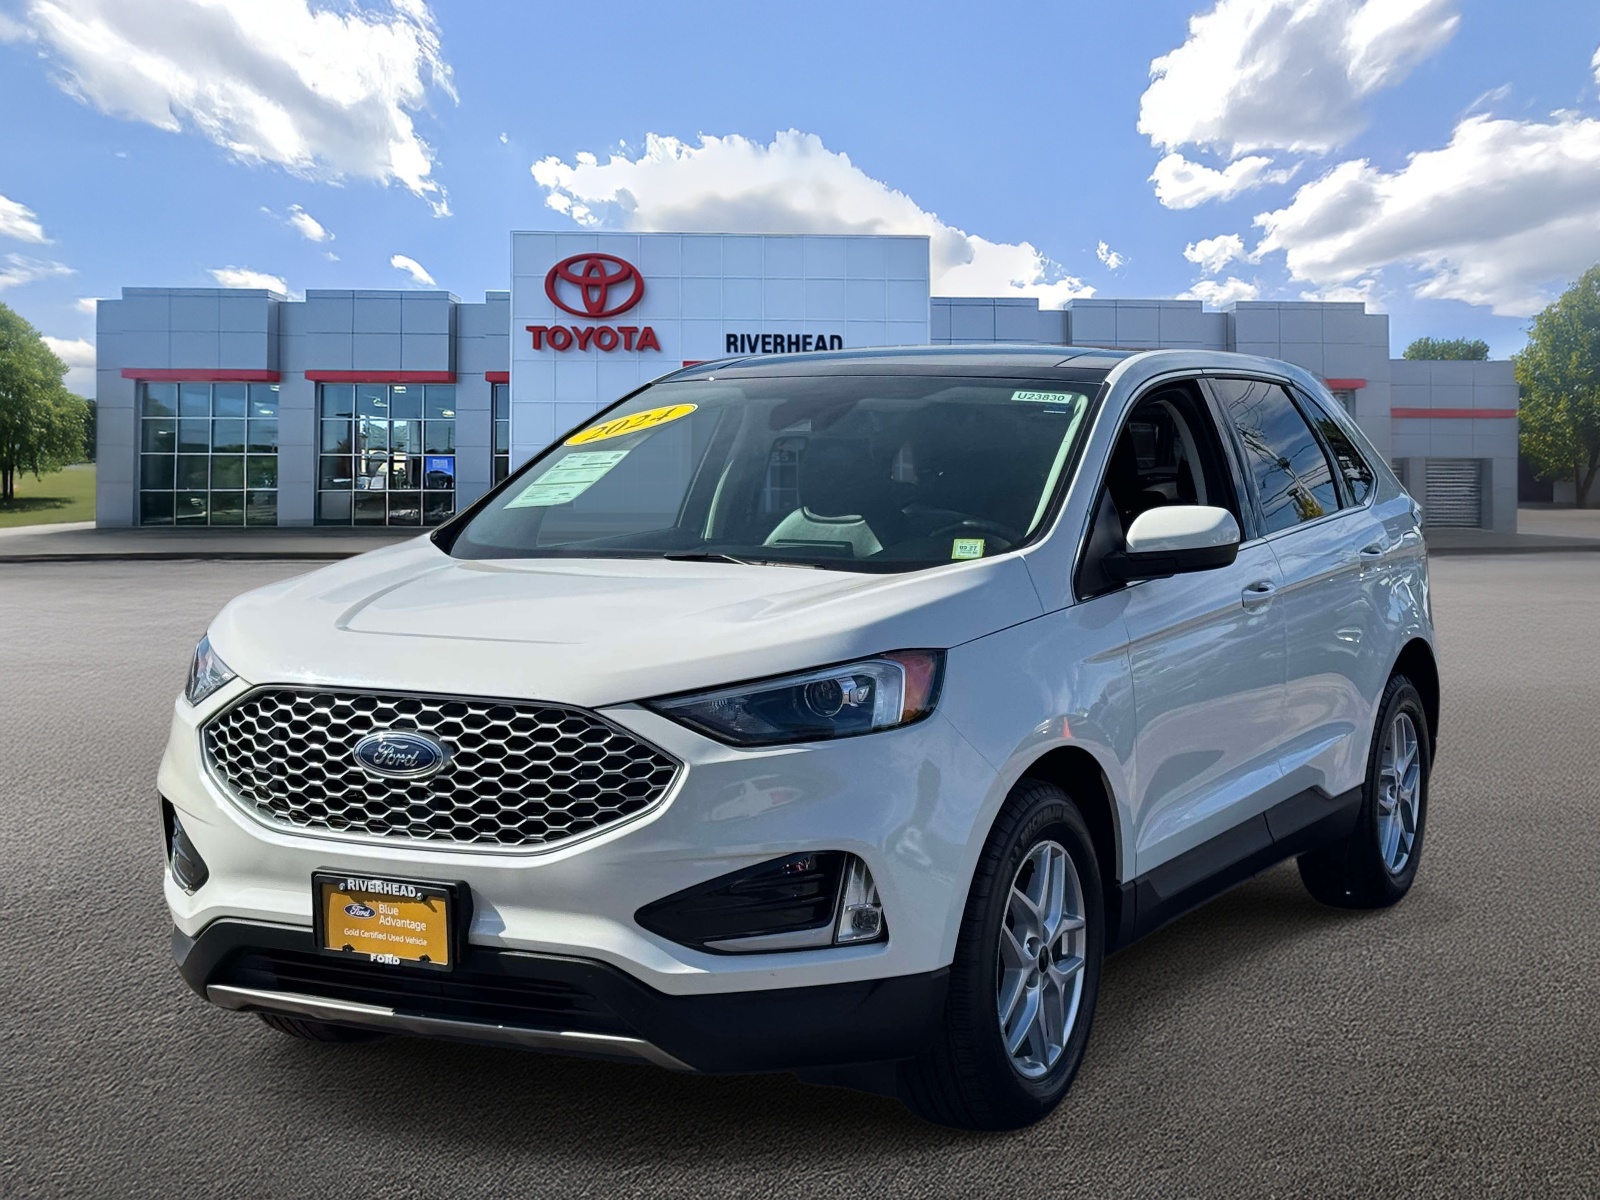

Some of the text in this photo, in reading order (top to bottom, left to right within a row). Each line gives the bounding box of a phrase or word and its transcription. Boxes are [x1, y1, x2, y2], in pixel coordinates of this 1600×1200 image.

[525, 325, 661, 351] TOYOTA
[726, 333, 843, 353] RIVERHEAD
[1017, 392, 1065, 402] U23830
[580, 406, 678, 443] 2024
[373, 741, 420, 767] Ford
[347, 879, 416, 898] RIVERHEAD
[349, 904, 372, 918] Ford
[378, 903, 399, 916] Blue
[378, 915, 427, 932] Advantage
[343, 927, 428, 947] Gold Certified Used Vehicle
[370, 953, 400, 966] FORD
